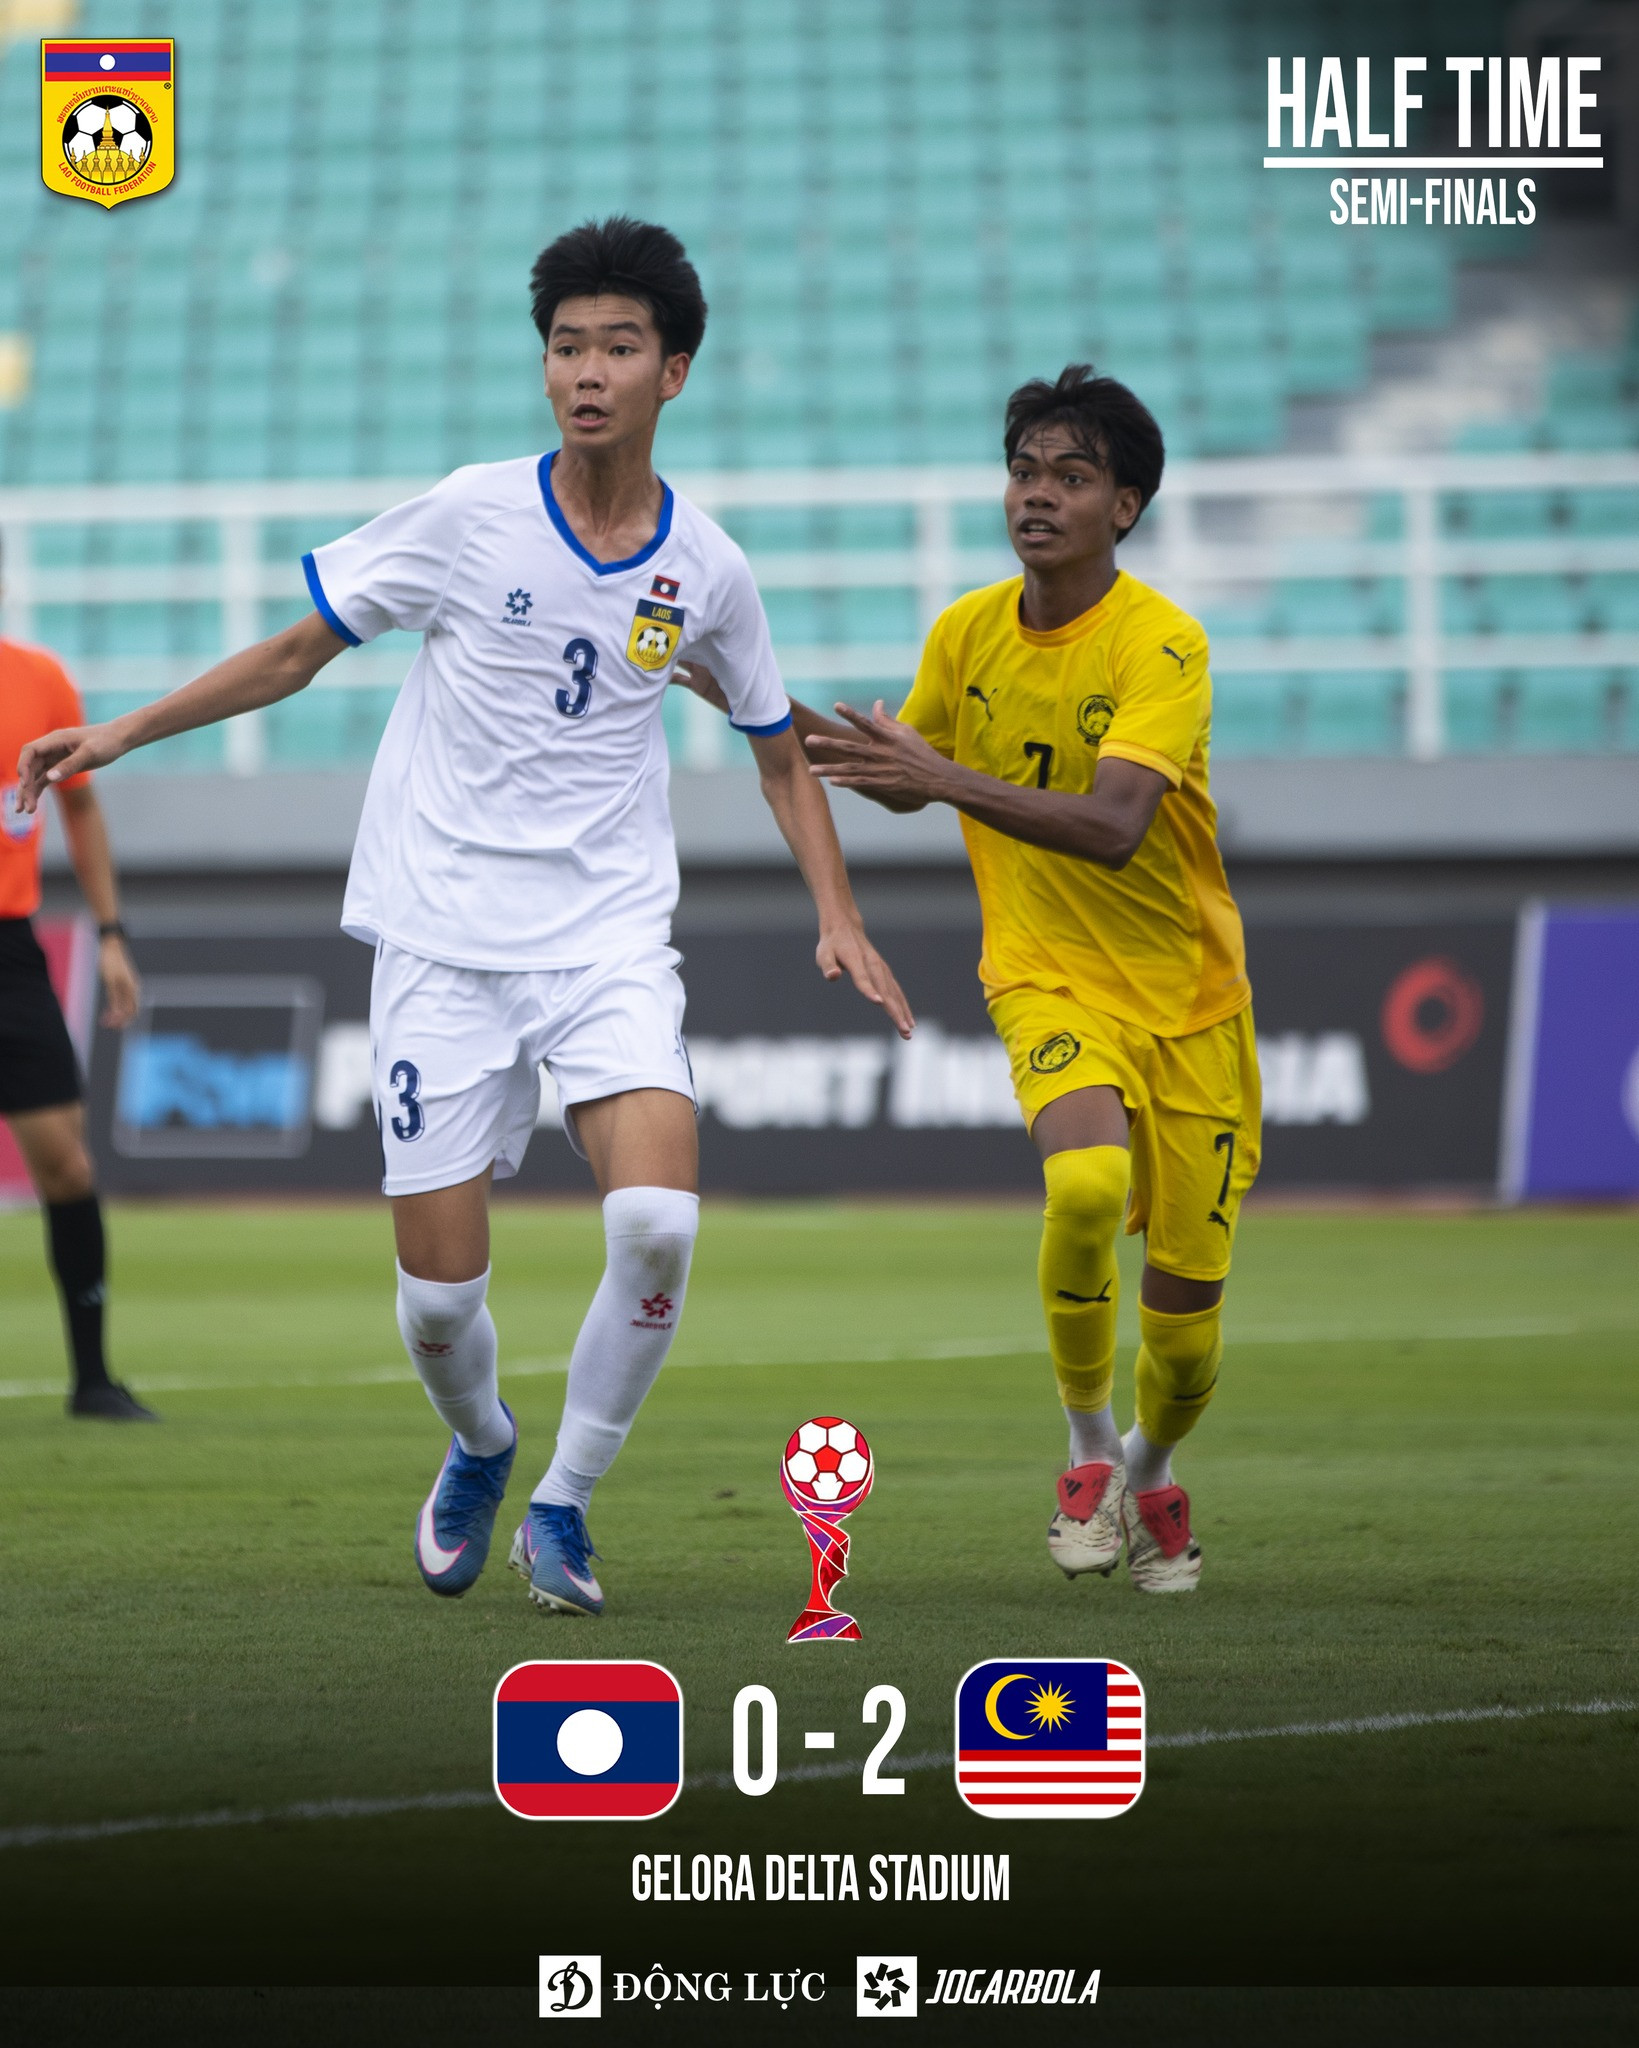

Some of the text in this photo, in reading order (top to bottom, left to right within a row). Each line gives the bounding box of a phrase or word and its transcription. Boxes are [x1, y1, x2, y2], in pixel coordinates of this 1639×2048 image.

[651, 606, 672, 620] LAOS
[555, 638, 598, 719] 3
[1023, 741, 1054, 789] 7
[389, 1059, 426, 1143] 3
[1214, 1131, 1235, 1208] 7
